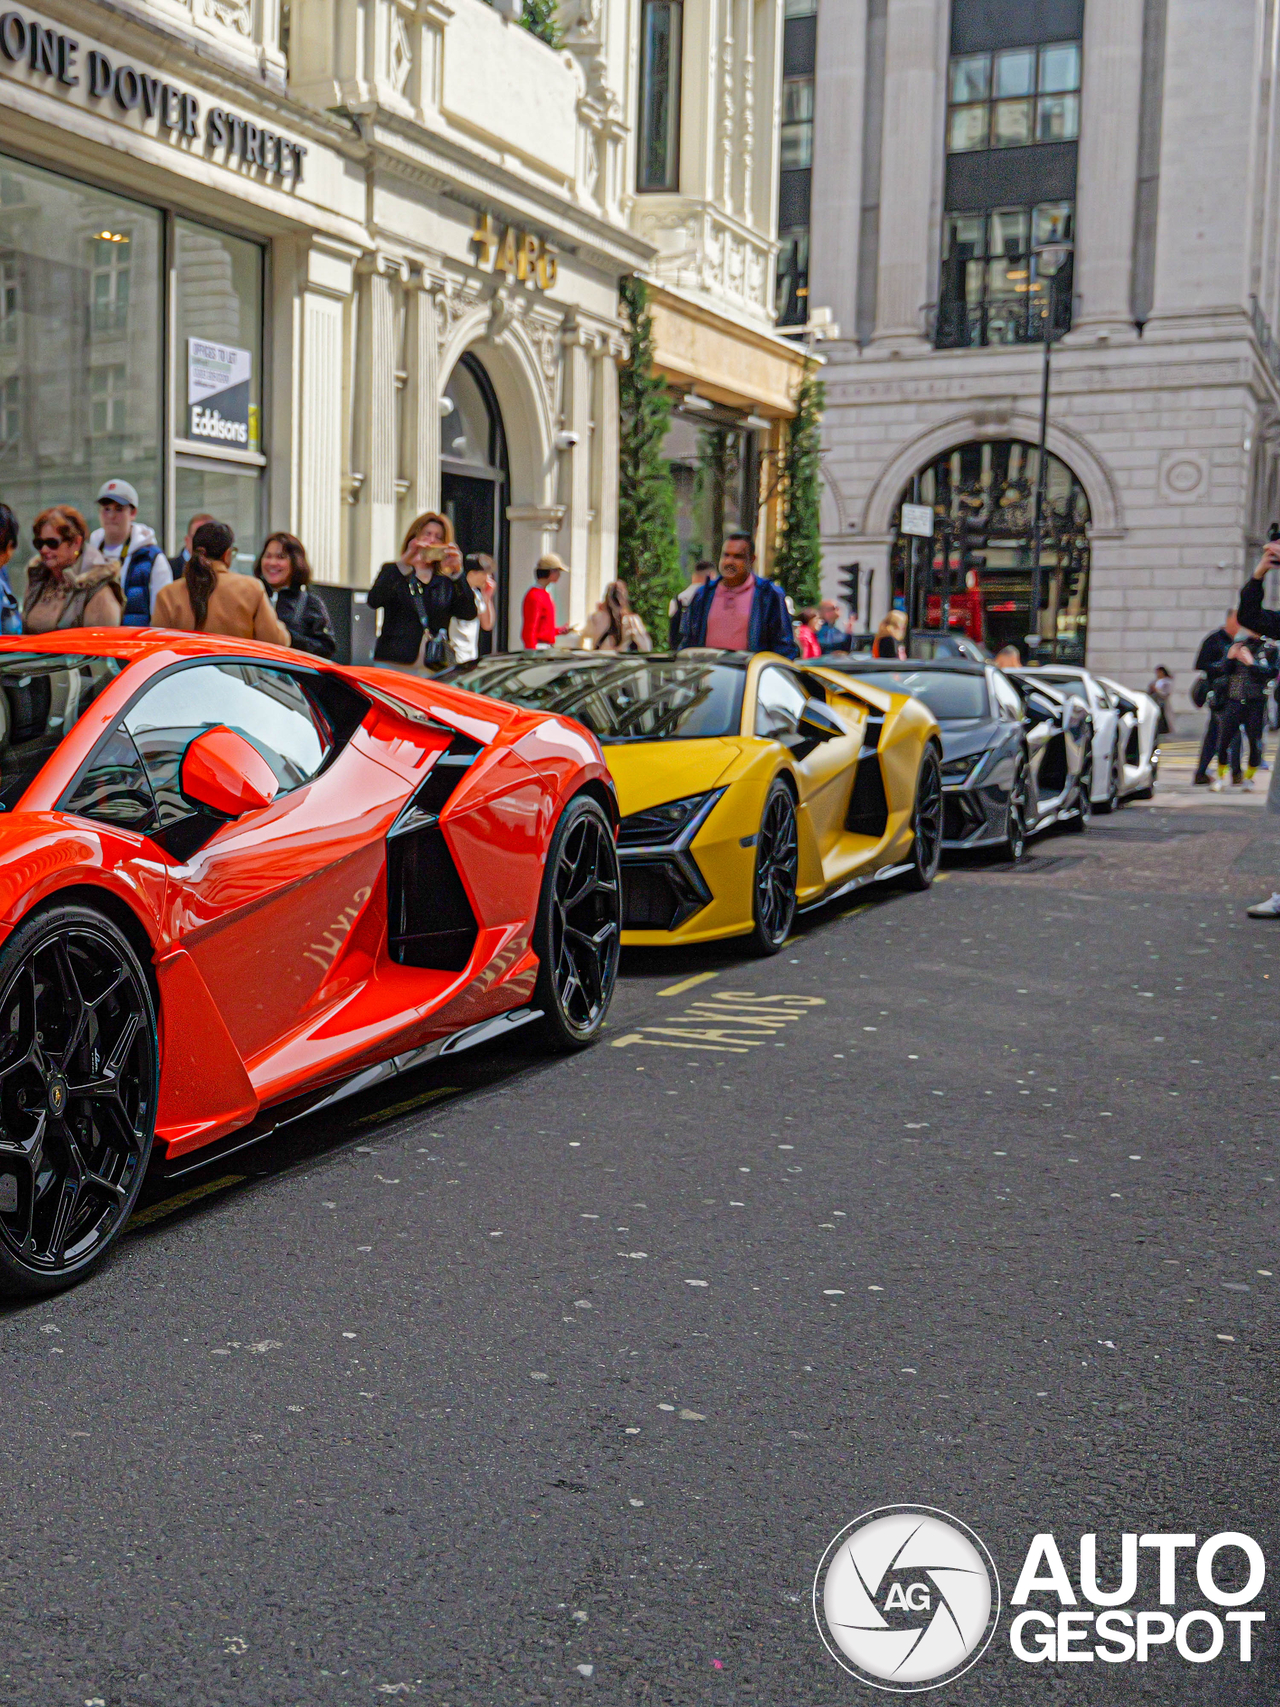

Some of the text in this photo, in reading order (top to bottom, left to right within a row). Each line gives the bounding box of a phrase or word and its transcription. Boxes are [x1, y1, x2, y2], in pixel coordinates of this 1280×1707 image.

[89, 50, 200, 138] DOVER
[207, 107, 307, 183] STREET
[191, 405, 248, 443] Eddisons
[608, 991, 827, 1053] TAXIS
